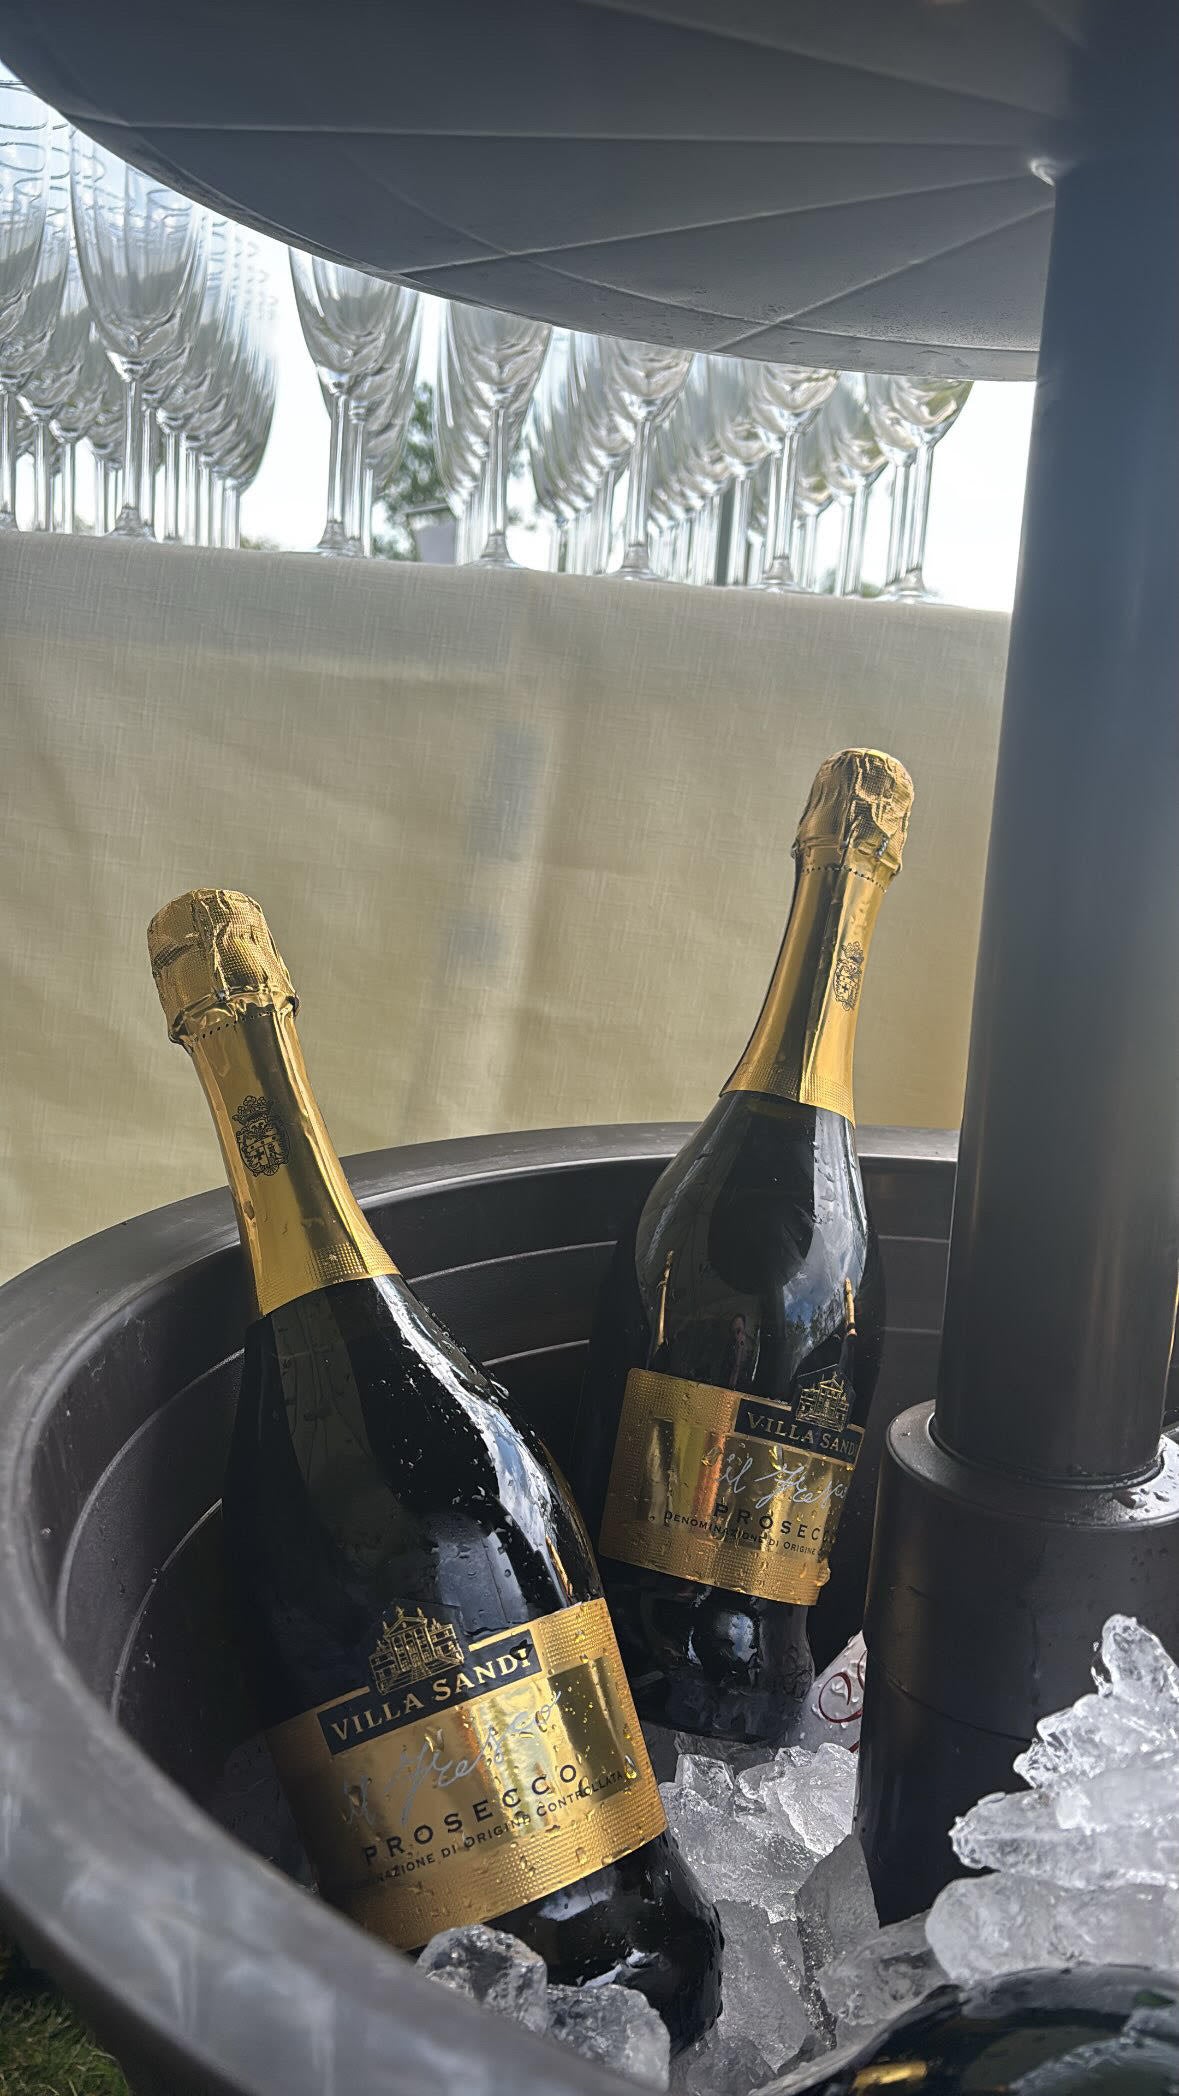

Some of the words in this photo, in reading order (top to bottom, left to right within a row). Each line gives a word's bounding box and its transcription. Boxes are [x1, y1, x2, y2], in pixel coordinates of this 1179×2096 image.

[748, 1411, 814, 1444] VILLA
[331, 1692, 425, 1741] VILLA
[432, 1648, 531, 1702] SANDI
[363, 1764, 578, 1866] PROSECCO
[441, 1844, 457, 1859] DI
